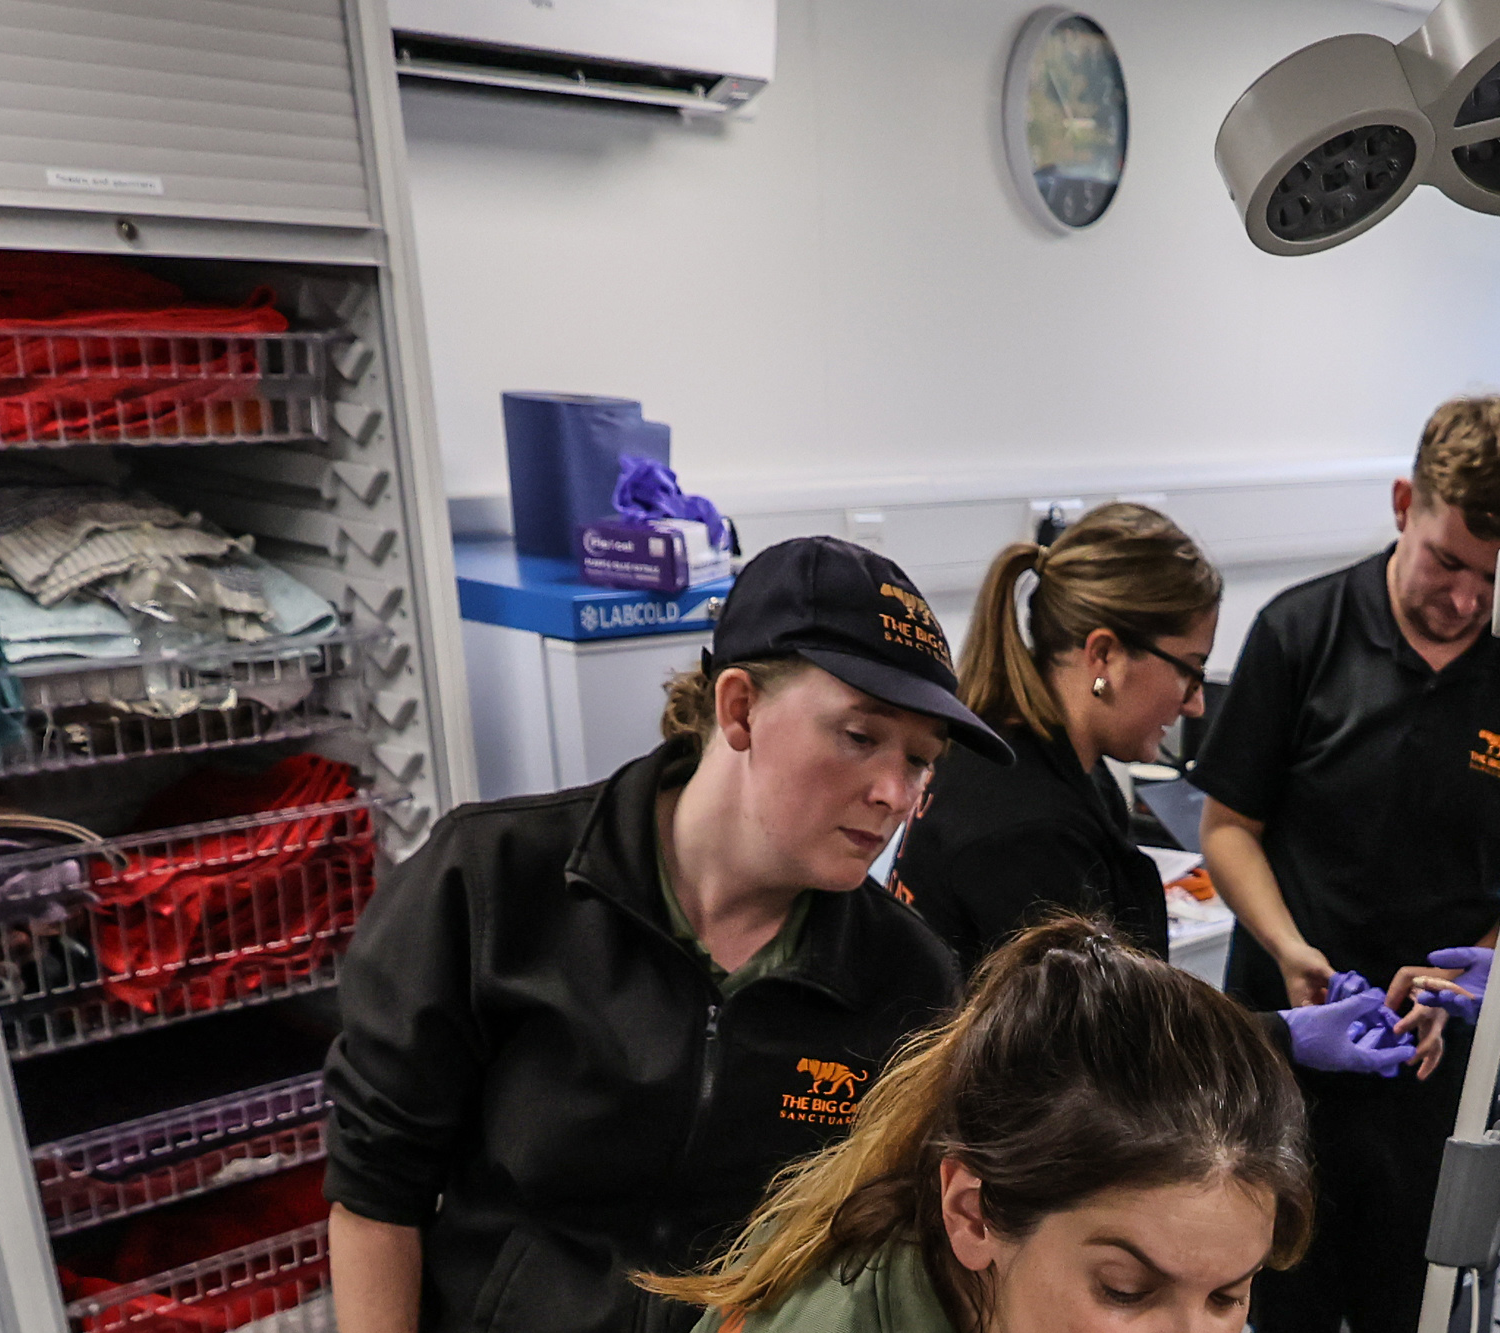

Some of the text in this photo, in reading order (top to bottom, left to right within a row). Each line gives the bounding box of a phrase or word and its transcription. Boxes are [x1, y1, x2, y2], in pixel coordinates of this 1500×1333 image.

[599, 601, 680, 628] LABCOLD
[879, 613, 911, 636] THE
[781, 1094, 860, 1114] THE BIG CA
[780, 1109, 855, 1126] SANCTUAR
